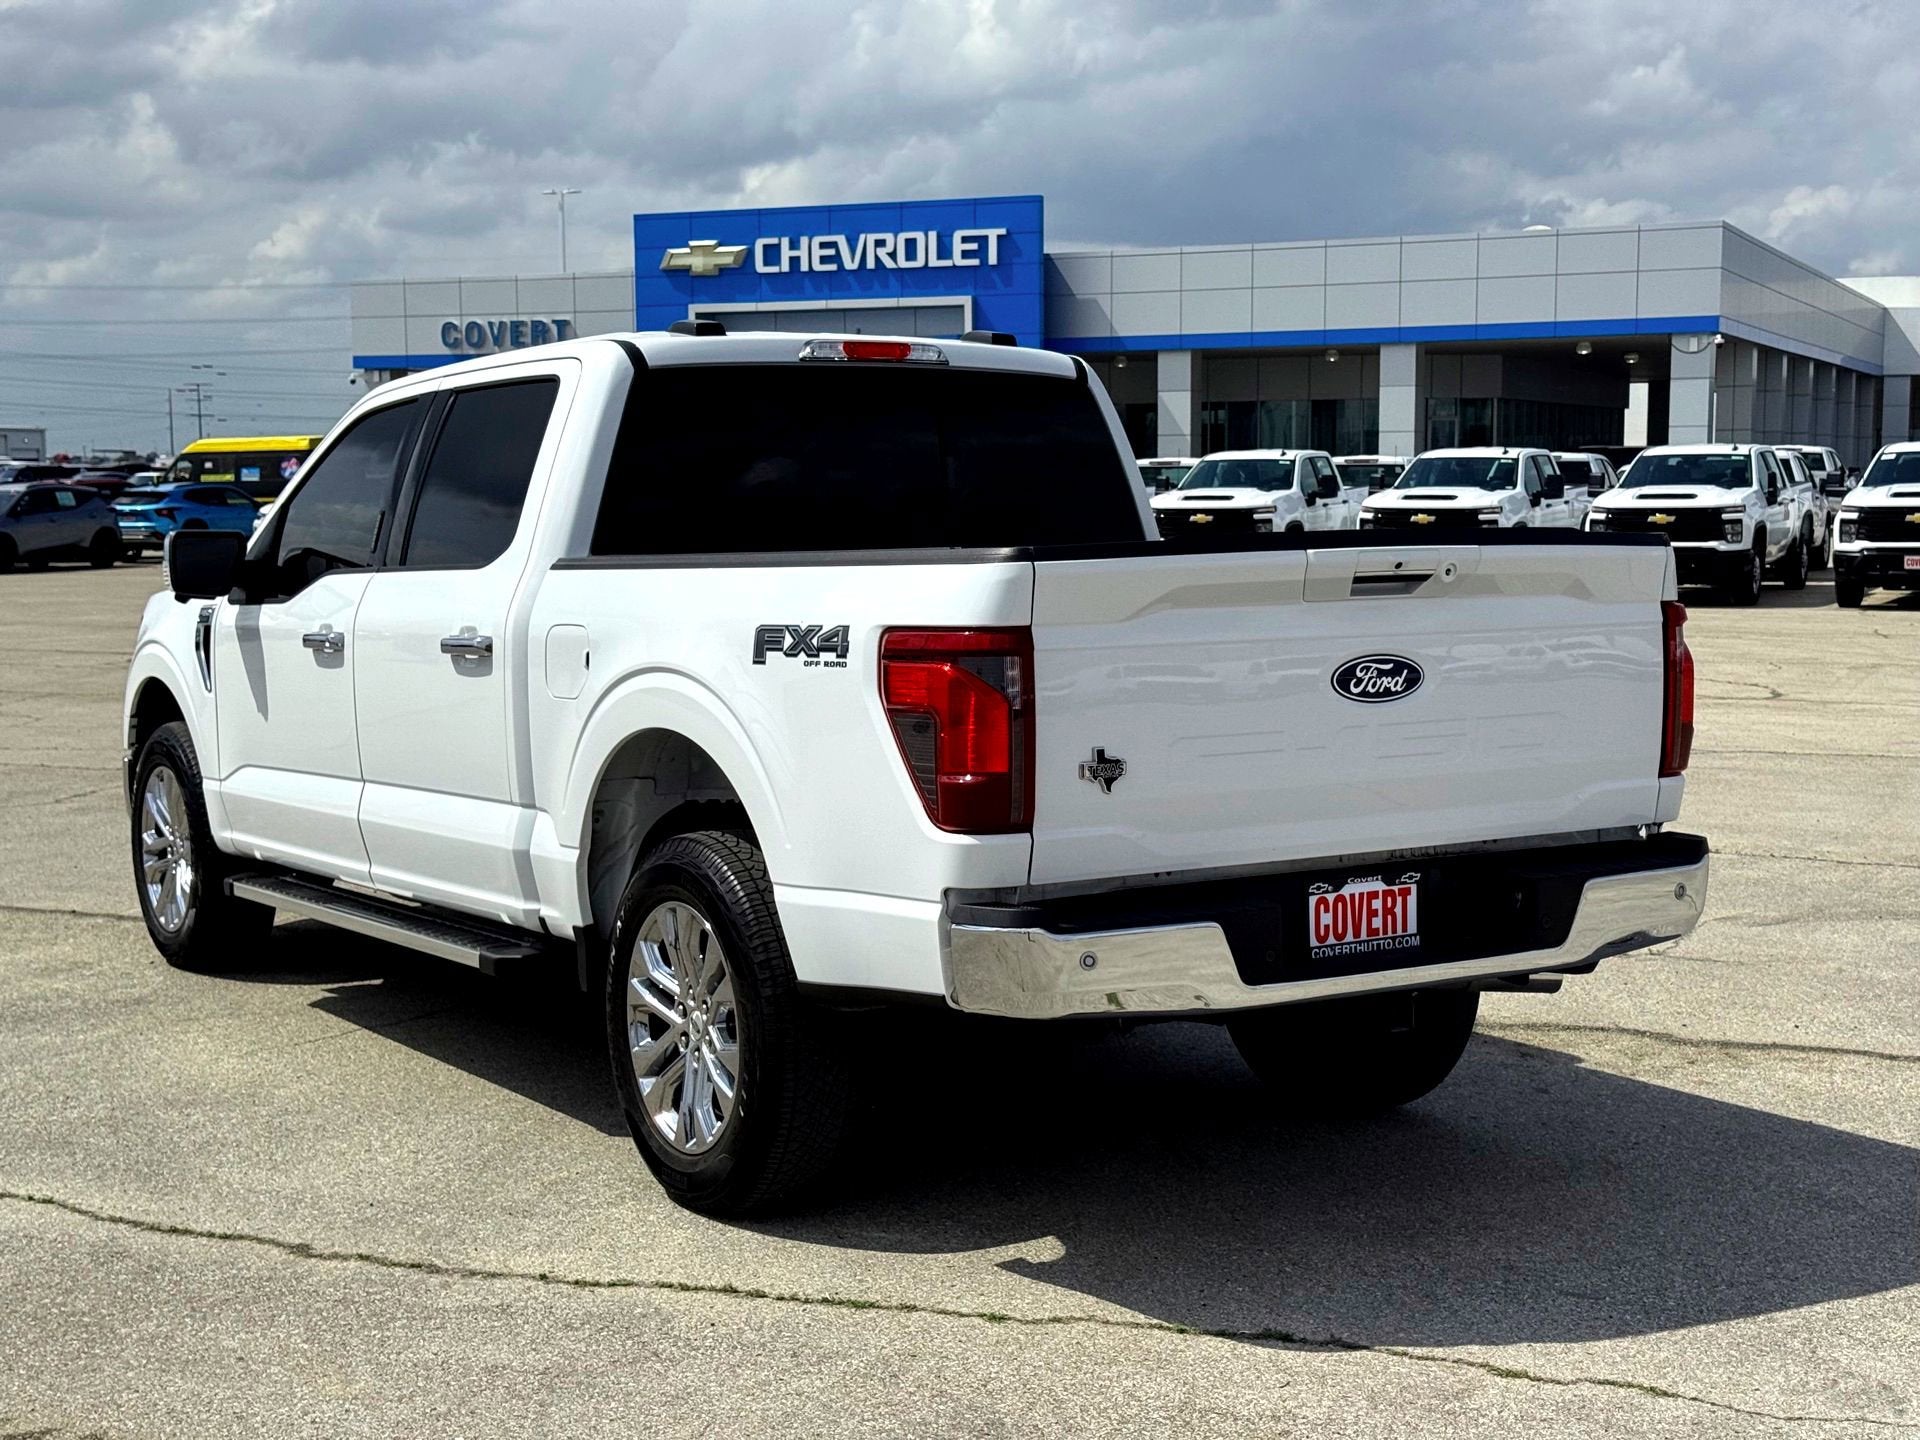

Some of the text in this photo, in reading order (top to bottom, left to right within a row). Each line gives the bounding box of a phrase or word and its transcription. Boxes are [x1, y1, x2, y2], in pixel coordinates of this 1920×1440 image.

[755, 228, 1007, 273] CHEVROLET
[441, 319, 572, 349] COVERT
[1906, 557, 1920, 568] COV
[752, 624, 850, 665] FX4
[1350, 663, 1408, 693] Ford
[1087, 763, 1125, 776] TEXAS
[1347, 875, 1382, 884] Covert
[1314, 886, 1412, 945] COVERT
[1311, 935, 1420, 959] COVERTHUTTO.COM
